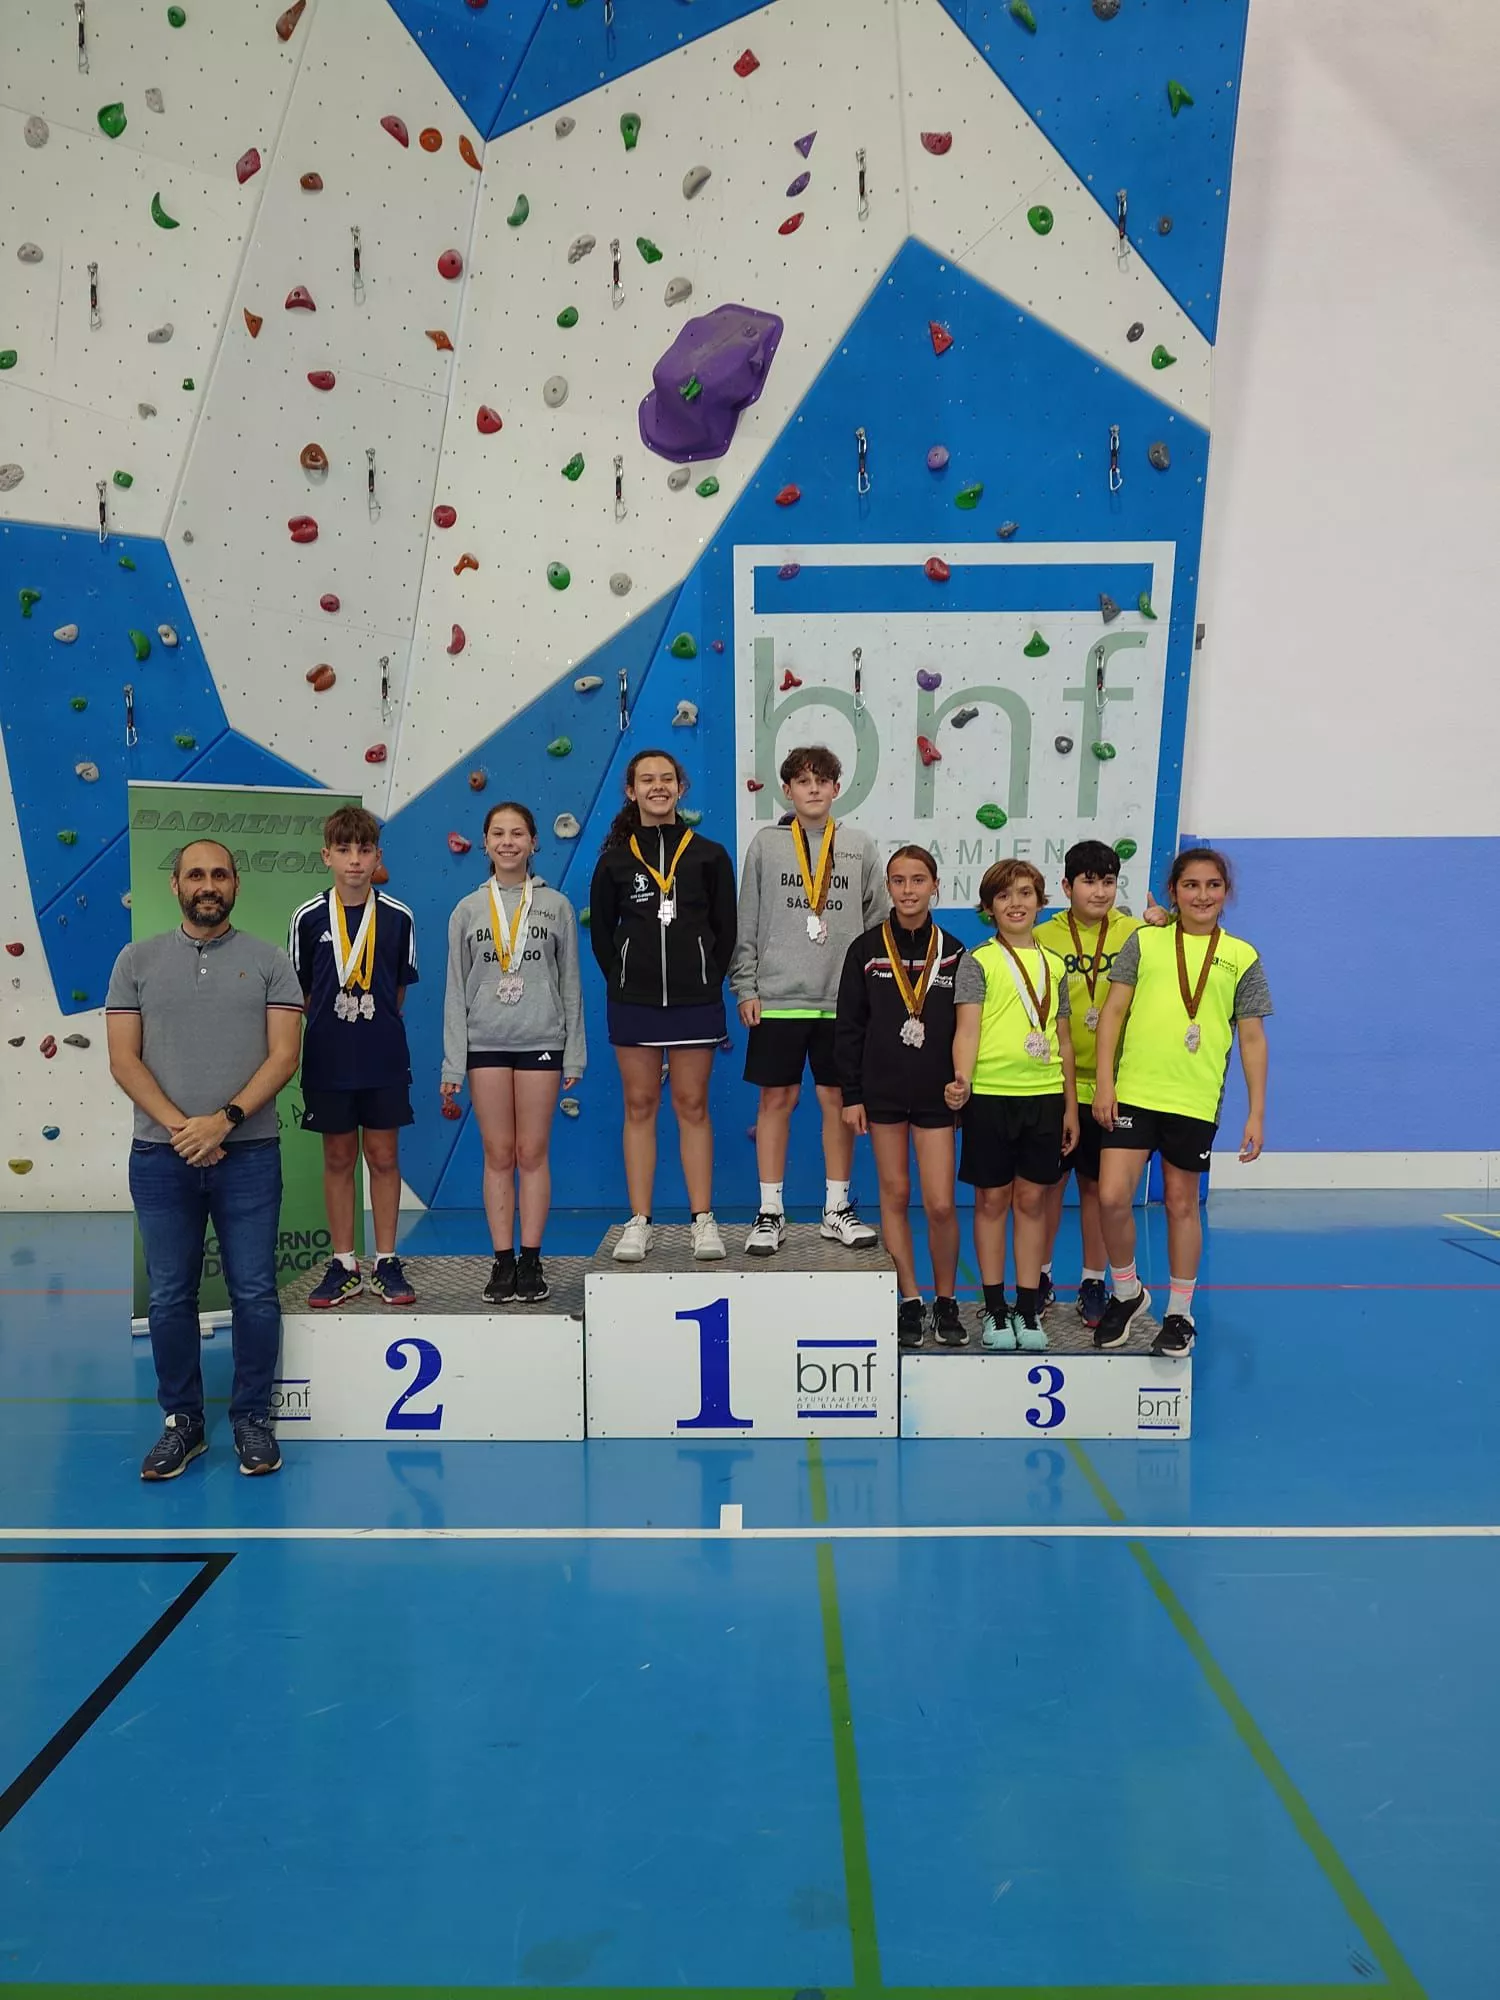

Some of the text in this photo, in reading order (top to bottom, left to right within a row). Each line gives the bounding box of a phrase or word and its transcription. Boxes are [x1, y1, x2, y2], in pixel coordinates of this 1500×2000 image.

[754, 631, 1148, 820] bnf
[131, 809, 326, 836] BADMINTO
[781, 873, 848, 890] BADTON
[786, 896, 843, 911] SÁSGO
[675, 1298, 753, 1428] 1
[797, 1352, 877, 1393] bnf
[385, 1338, 443, 1430] 2
[1025, 1365, 1066, 1429] 3
[1138, 1394, 1181, 1417] bnf
